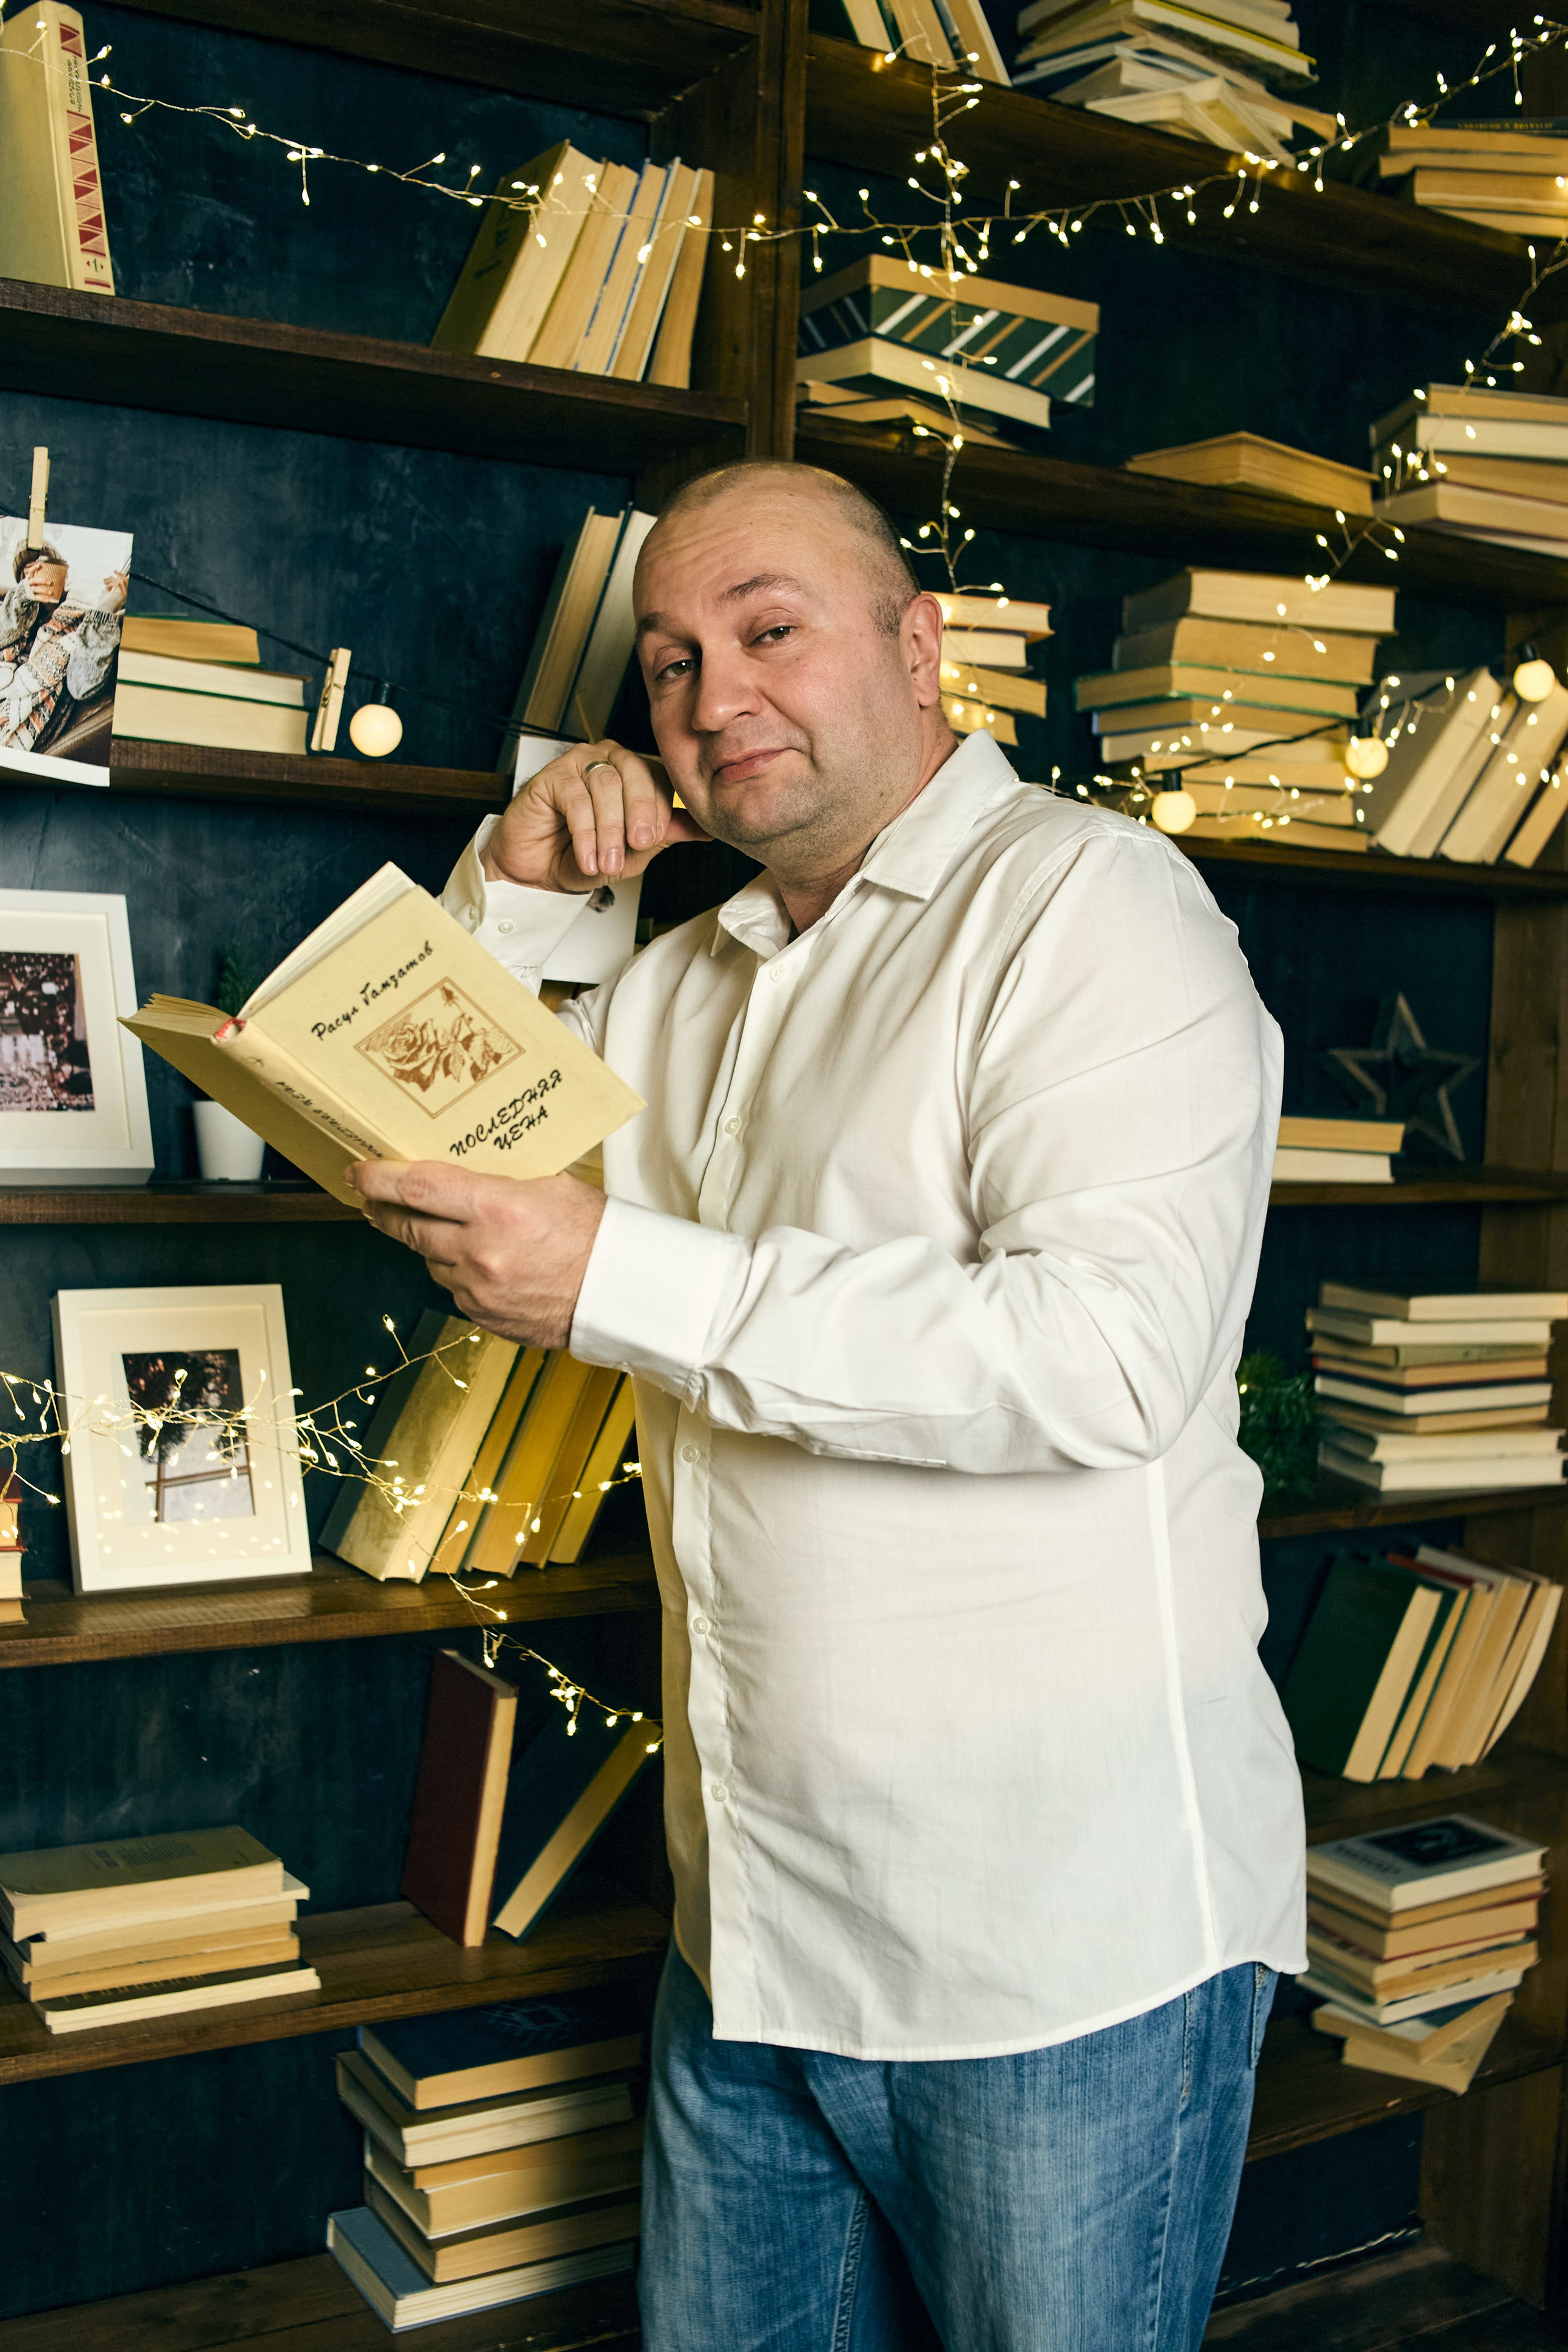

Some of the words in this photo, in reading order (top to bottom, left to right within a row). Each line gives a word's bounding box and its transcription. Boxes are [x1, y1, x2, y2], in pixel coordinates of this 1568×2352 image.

[311, 1006, 360, 1041] Расул
[360, 941, 434, 1006] Гамзатов
[450, 1069, 563, 1156] ПОСЛЕДНЯЯ
[494, 1105, 549, 1150] ЦЕНА
